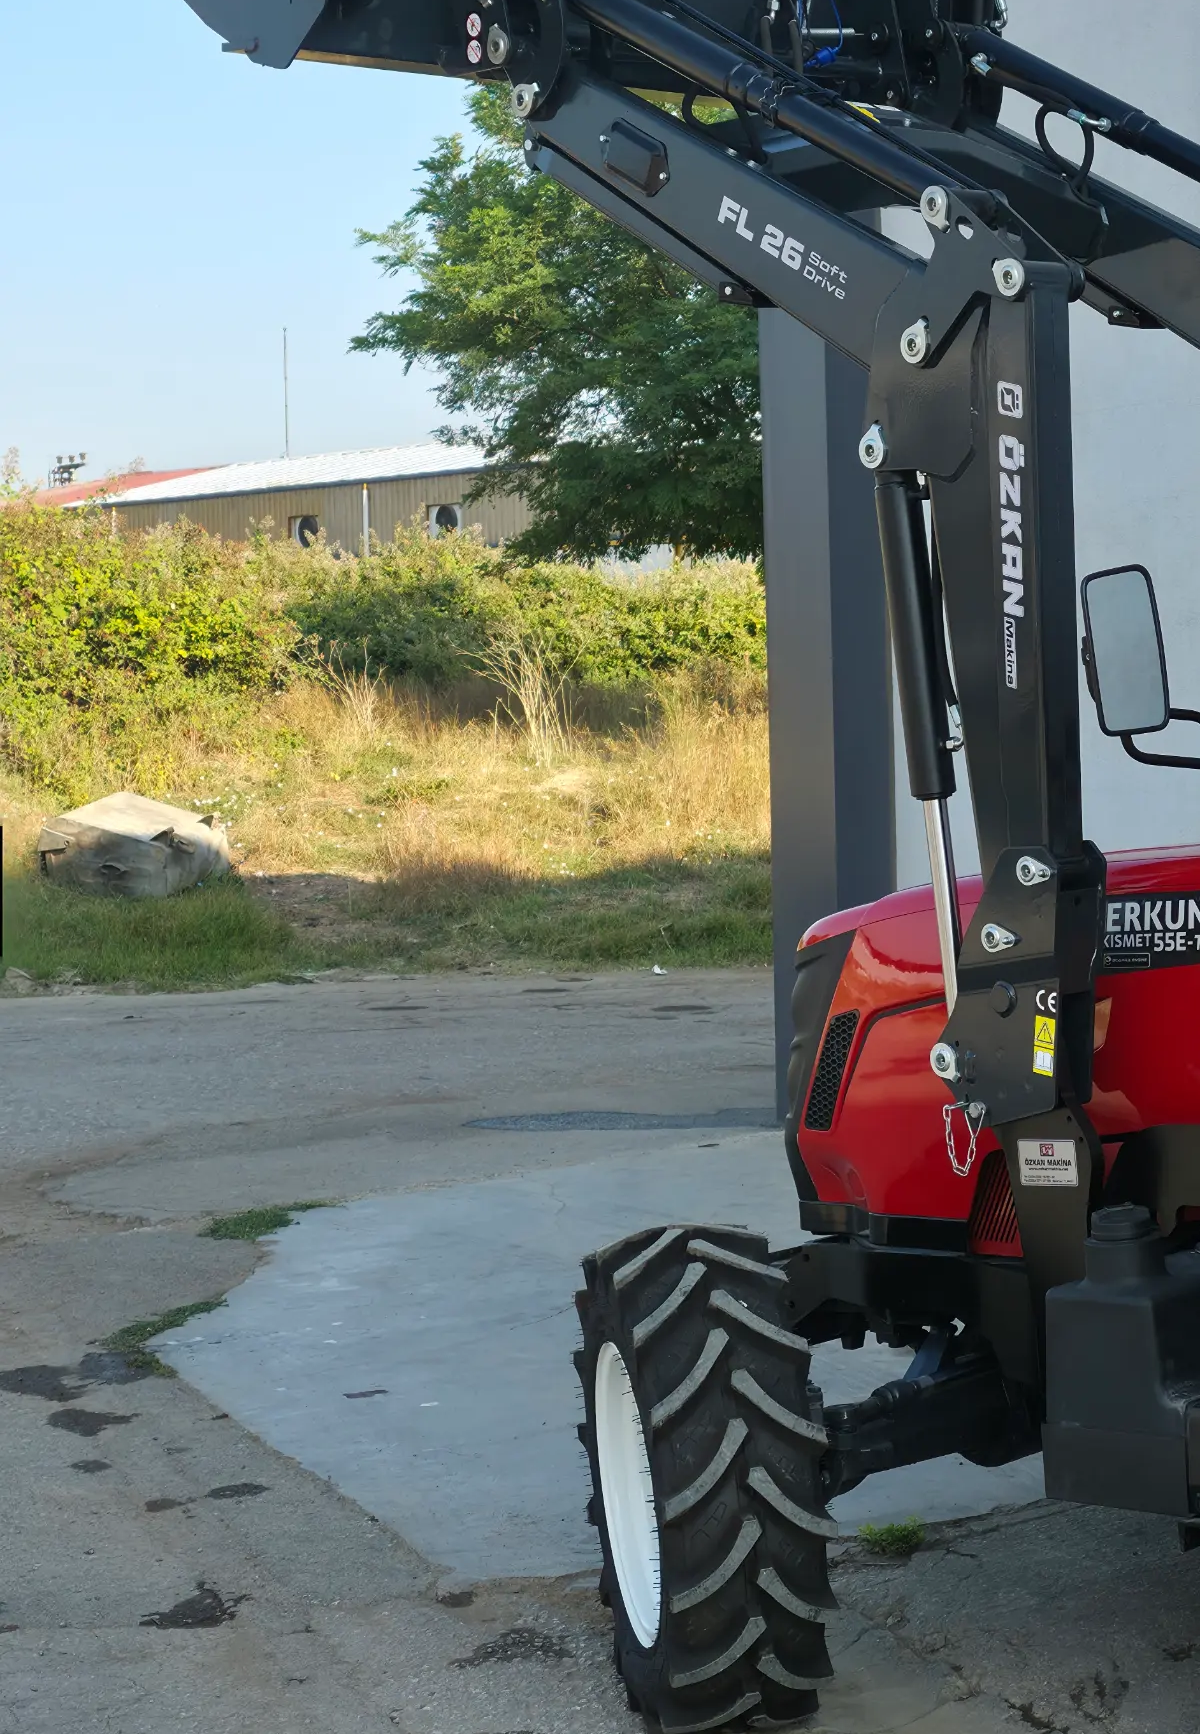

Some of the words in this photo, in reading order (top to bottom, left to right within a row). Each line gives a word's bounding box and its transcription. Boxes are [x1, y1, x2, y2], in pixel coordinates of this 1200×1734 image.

[717, 195, 754, 242] FL
[760, 223, 805, 271] 26
[803, 265, 846, 300] Drive
[808, 251, 848, 284] Soft
[998, 434, 1025, 618] ÖZKAN
[1035, 989, 1058, 1013] CE
